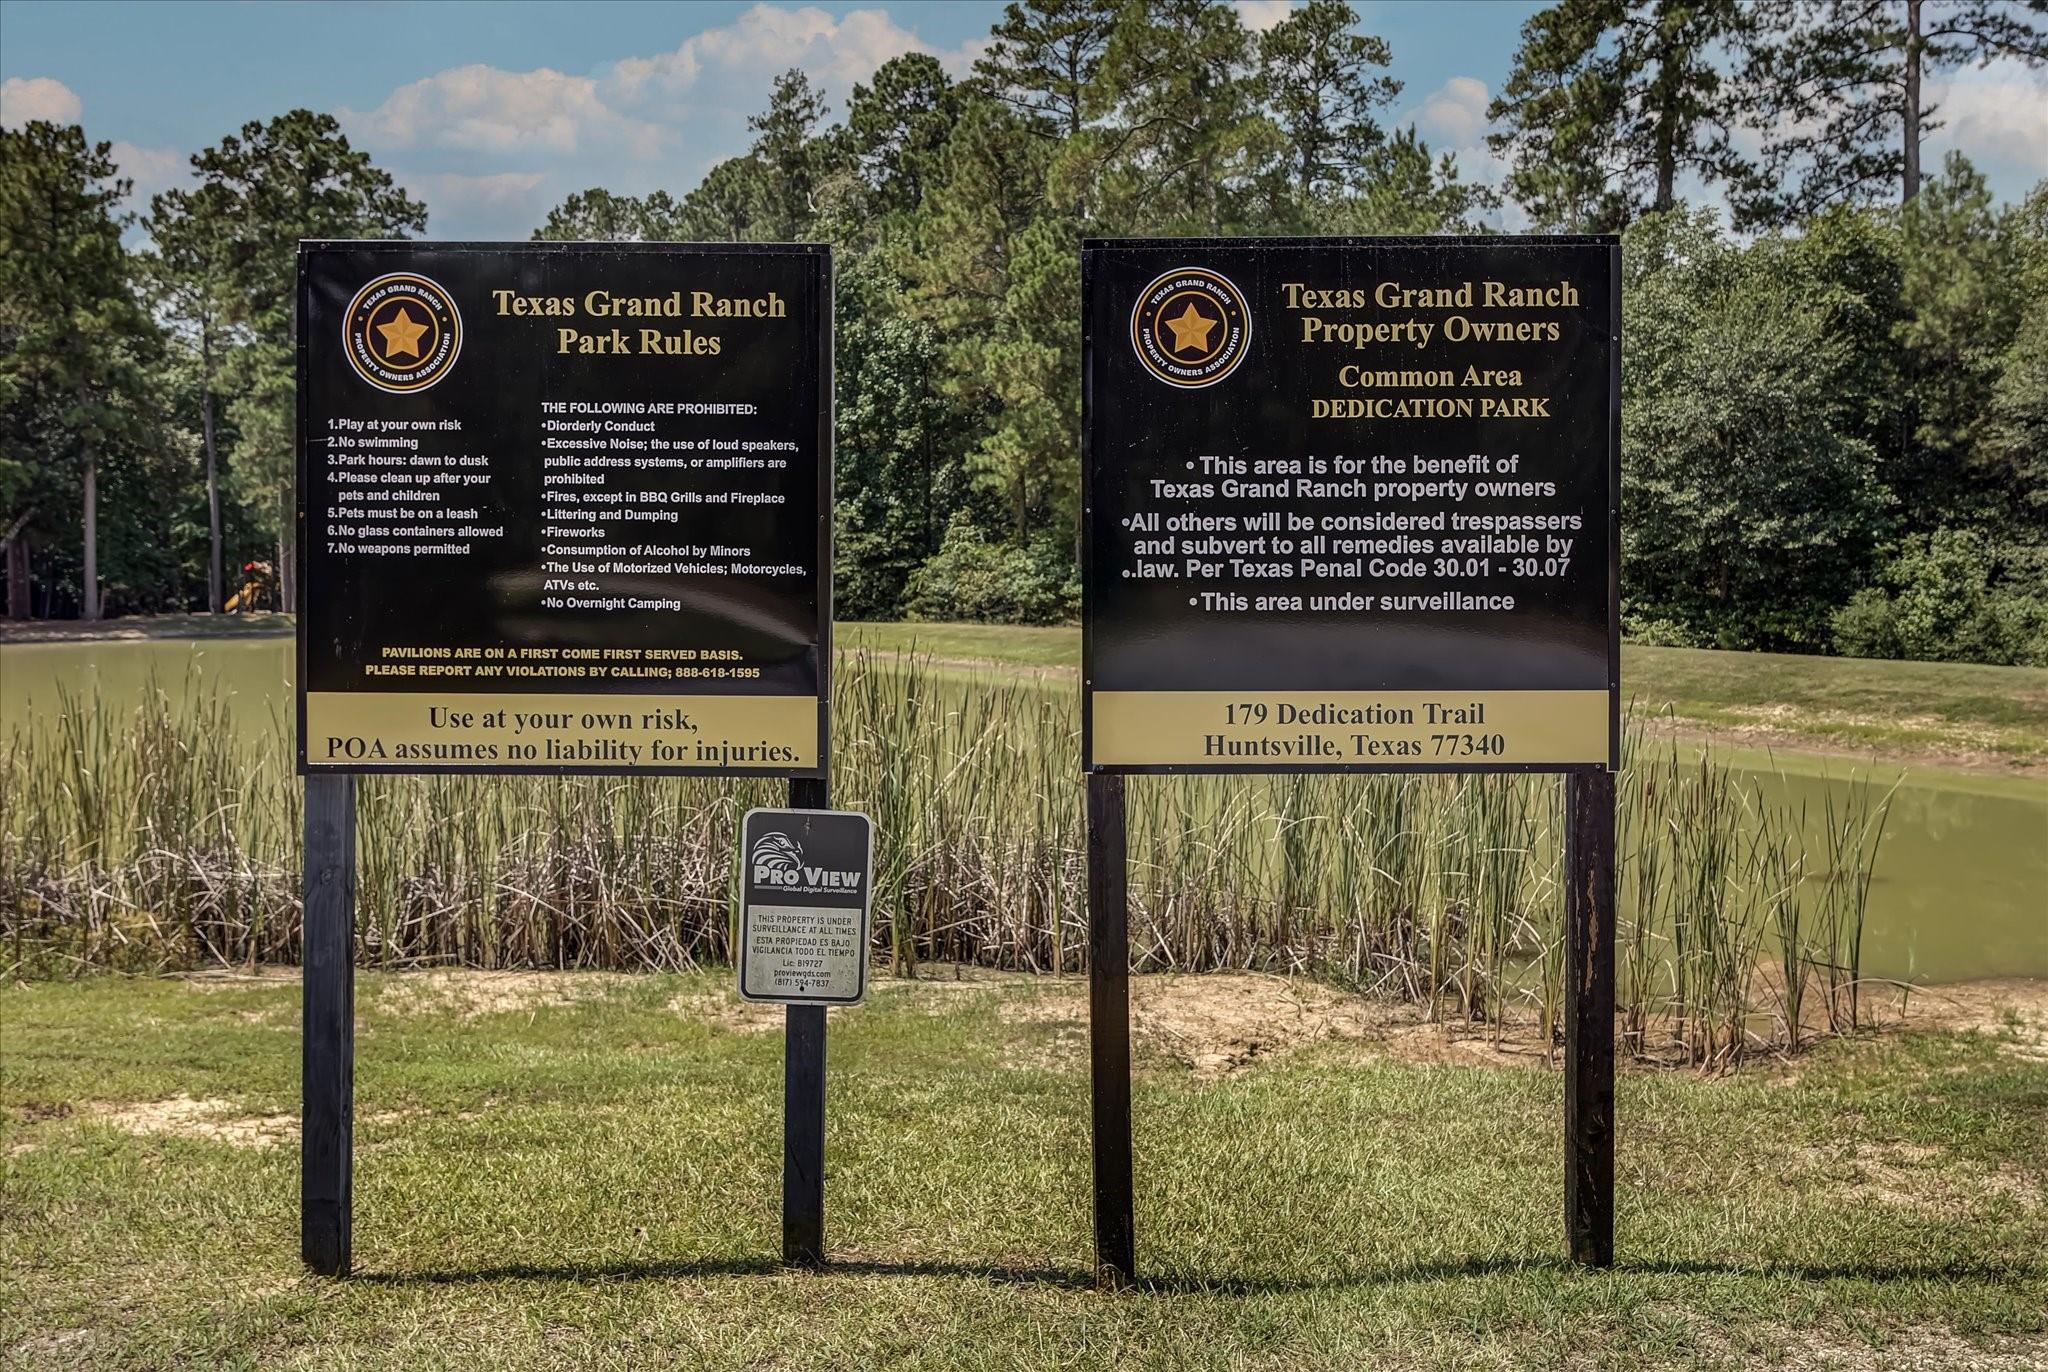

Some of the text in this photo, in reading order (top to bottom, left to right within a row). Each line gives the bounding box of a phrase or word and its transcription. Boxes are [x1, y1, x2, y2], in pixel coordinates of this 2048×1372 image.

[1151, 279, 1231, 305] TEXAS GRAND RANCH
[1281, 280, 1579, 308] Texas Grand Ranch
[492, 290, 786, 317] Texas Grand Ranch
[1301, 315, 1559, 349] Property Owners
[557, 328, 720, 355] Park Rules
[1143, 327, 1239, 376] PROPERTY OWNERS ASSOCIATION
[1338, 364, 1522, 387] Common Area
[540, 402, 757, 414] THE FOLLOWING ARE PROHIBITED:
[1311, 397, 1550, 418] DEDICATION PARK
[327, 418, 461, 432] 1.Play at your own risk
[547, 419, 655, 433] Diorderly Conduct
[327, 436, 418, 450] 2.No swimming
[327, 454, 488, 466] 3.Park hours: dawn to dusk
[1199, 454, 1519, 474] This area is for the benefit of
[1150, 478, 1556, 501] Texas Grand Ranch property owners
[547, 490, 785, 505] Fires, except in BBQ Grills and Fireplace
[547, 508, 678, 522] Littering and Dumping
[1129, 511, 1582, 534] All others will be considered trespassers
[327, 524, 503, 538] 6.No glass containers allowed
[547, 526, 605, 537] Fireworks
[327, 542, 470, 556] 7.No weapons permitted
[546, 543, 750, 558] Consumption of Alcohol by Minors
[1186, 558, 1224, 577] Per
[1229, 558, 1293, 577] Texas
[1300, 558, 1361, 577] Penal
[1368, 557, 1427, 577] Code
[1433, 557, 1488, 577] 30.01
[1512, 557, 1570, 576] 30.07
[547, 596, 680, 611] No Overnight Camping
[1200, 591, 1514, 611] This area under surveillance
[382, 647, 743, 660] PAVILIONS ARE ON A FIRST COME FIRST SERVED BASIS.
[365, 664, 760, 679] PLEASE REPORT ANY VIOLATIONS BY CALLING; 888-618-1595
[428, 706, 697, 735] Use at your own risk,
[1225, 702, 1485, 725] 179 Dedication Trail
[326, 736, 800, 767] POA assumes no liability for injuries.
[1204, 733, 1504, 760] Huntsville, Texas 77340
[758, 915, 775, 923] THIS
[777, 916, 815, 924] PROPERTY
[827, 917, 852, 925] UNDER
[752, 925, 806, 934] SURVEILLANCE
[809, 926, 816, 934] AT
[835, 927, 856, 935] TIMES
[775, 937, 817, 946] PROPIEDAD
[831, 939, 850, 947] BAJO
[752, 946, 793, 954] VIGILANCIA
[795, 948, 814, 956] TODO
[828, 949, 855, 957] TIEMPO
[795, 979, 829, 987] 594-7837
